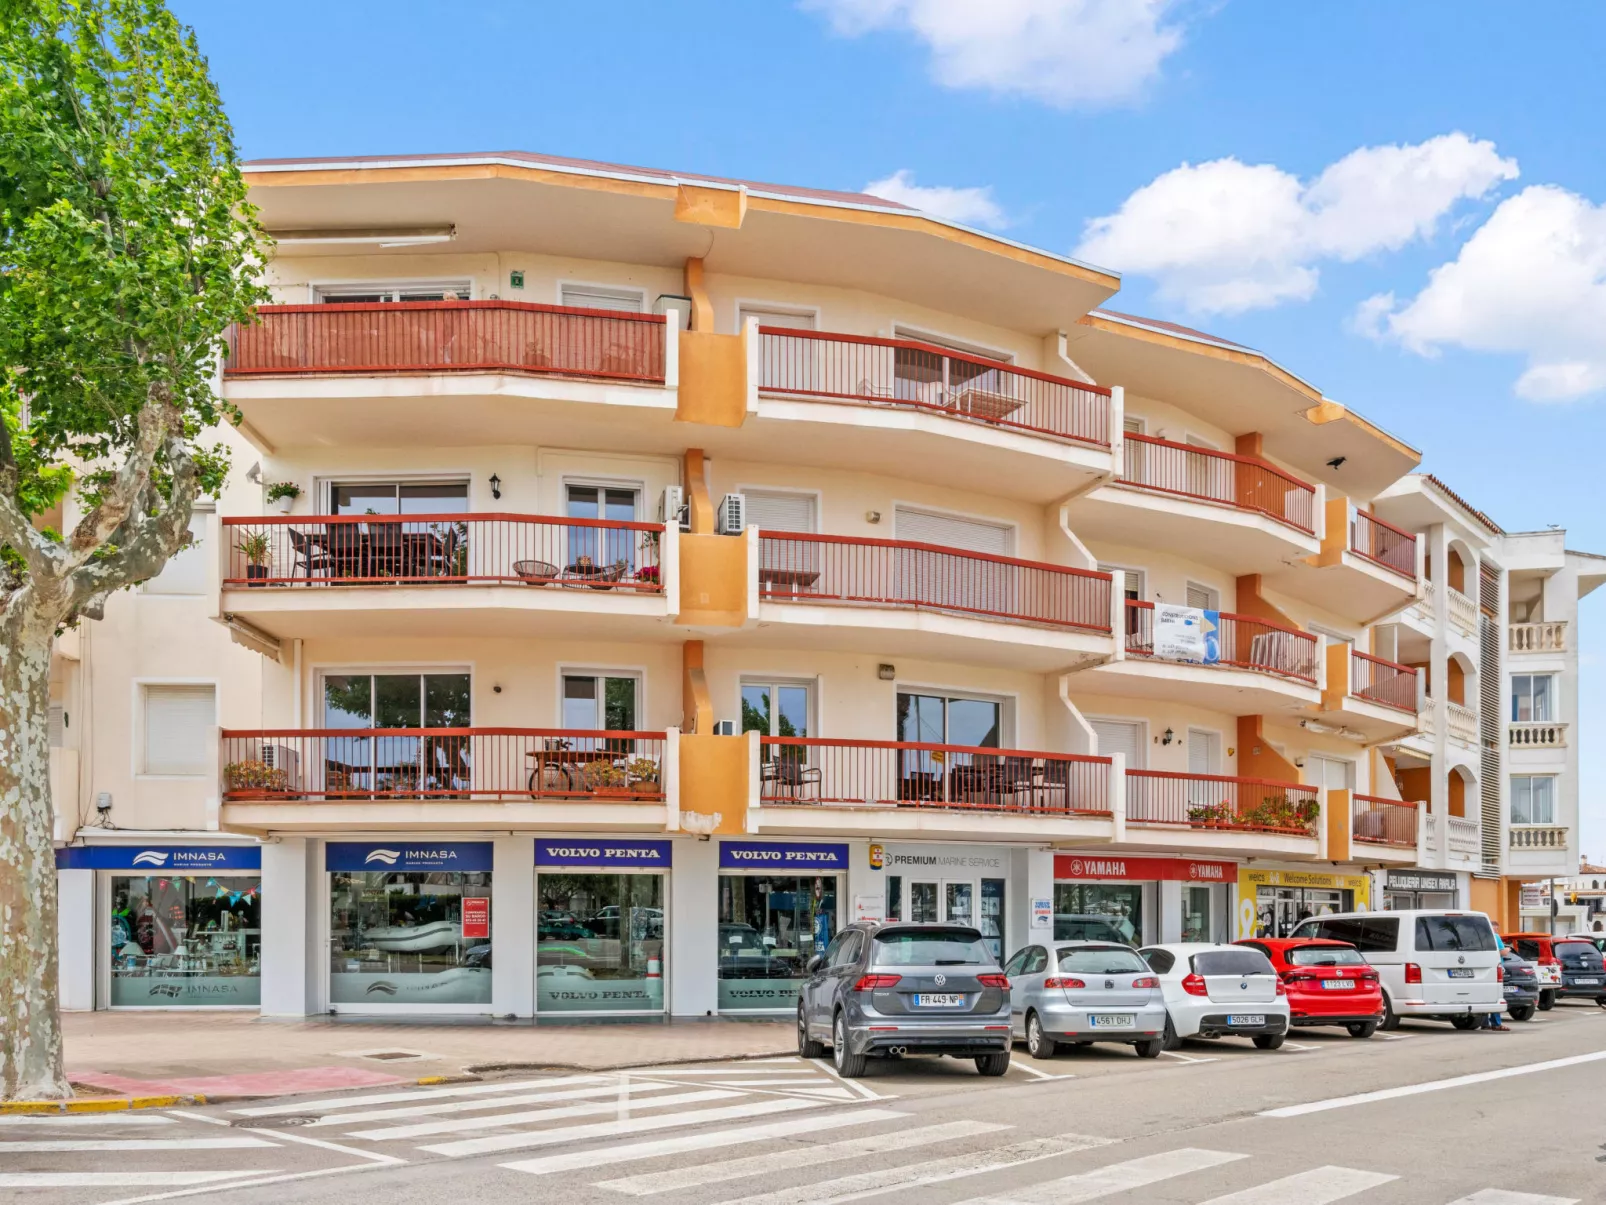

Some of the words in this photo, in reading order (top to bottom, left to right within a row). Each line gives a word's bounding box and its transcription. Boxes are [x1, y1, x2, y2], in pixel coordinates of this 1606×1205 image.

[173, 852, 226, 861] IMNASA
[405, 850, 458, 859] IMNASA
[546, 847, 601, 857] VOLVO
[604, 848, 661, 858] PENTA
[730, 850, 782, 860] VOLVO
[785, 851, 838, 861] PENTA
[894, 855, 937, 865] PREMIUM
[938, 857, 967, 866] MARINE
[968, 858, 1000, 868] SERVICE
[1083, 861, 1126, 876] YAMAHA
[1197, 864, 1223, 878] YAMAHA
[1284, 873, 1308, 883] Welcome
[1308, 874, 1332, 885] Solutions
[1420, 877, 1439, 889] UNISEX
[187, 985, 238, 994] IMNASA
[729, 989, 775, 998] VOLVO
[549, 991, 598, 1000] VOLVO
[1096, 1016, 1114, 1024] 4561
[1232, 1015, 1249, 1023] 5026
[1250, 1015, 1264, 1024] GLH
